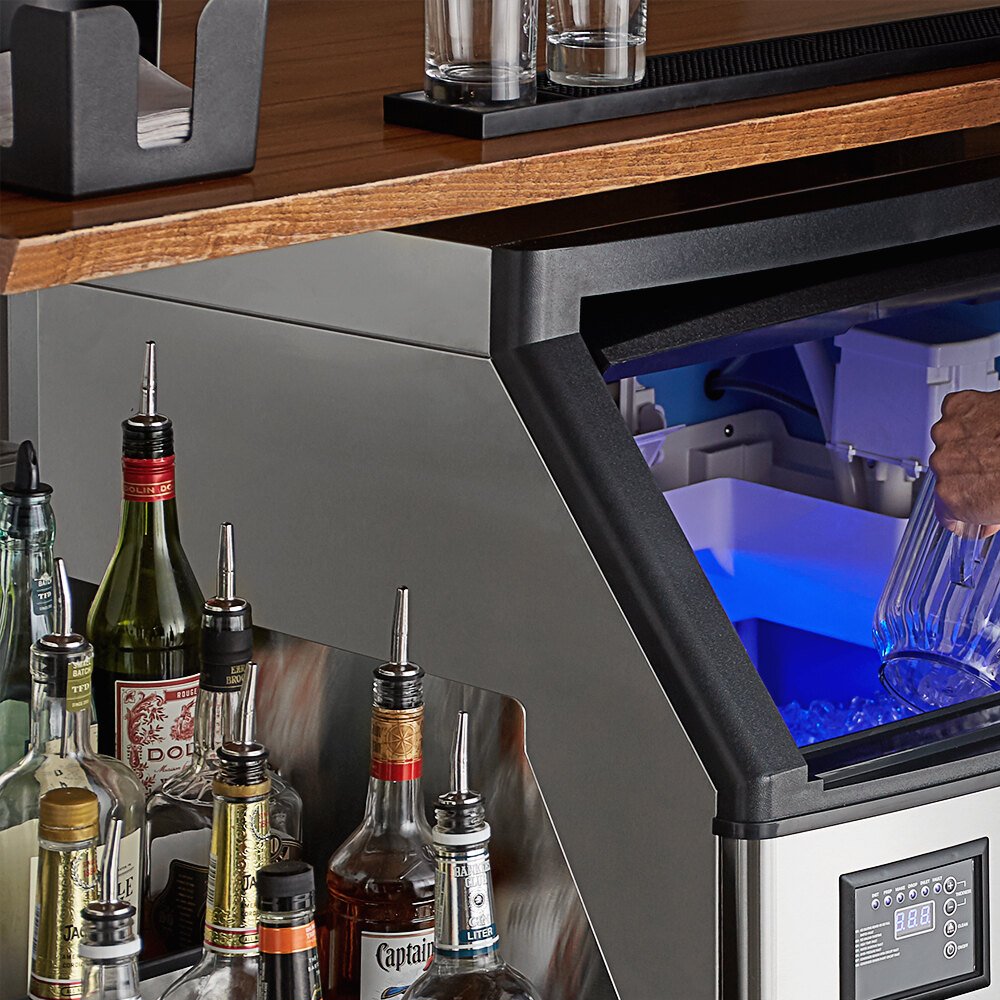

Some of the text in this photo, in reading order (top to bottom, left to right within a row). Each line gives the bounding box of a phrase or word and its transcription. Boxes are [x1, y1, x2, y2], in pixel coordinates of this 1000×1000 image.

[71, 682, 90, 693] TFD
[176, 687, 197, 698] ROUGE
[467, 926, 494, 941] LITER
